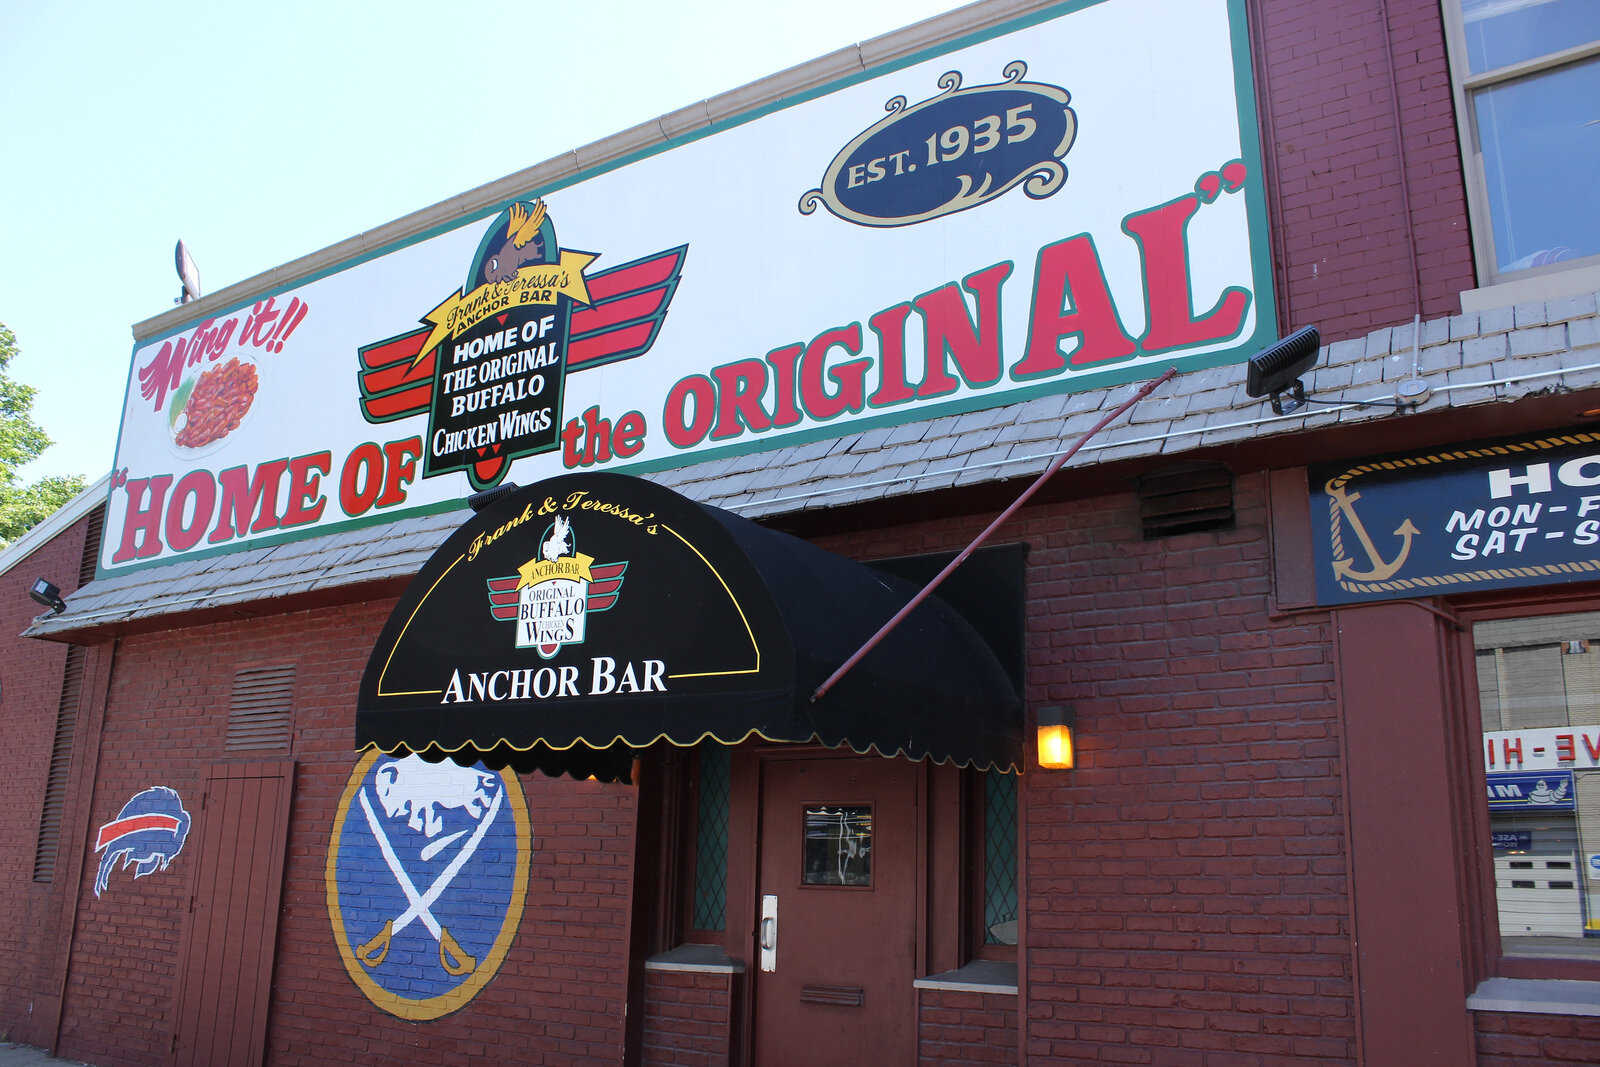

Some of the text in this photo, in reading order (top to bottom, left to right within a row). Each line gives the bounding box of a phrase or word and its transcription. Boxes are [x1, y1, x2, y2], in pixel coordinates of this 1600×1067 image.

[847, 103, 1037, 189] EST. 1935
[446, 287, 491, 330] Frank
[503, 270, 571, 295] Teressa's
[457, 290, 552, 335] ANCHOR BAR
[138, 296, 308, 412] Wing it!!
[453, 314, 555, 365] HOME OF
[442, 342, 559, 394] THE ORIGINAL
[451, 374, 545, 417] BUFFALO
[432, 407, 551, 457] CHICKEN WINGS
[339, 434, 424, 517] OF
[561, 405, 647, 469] the
[1488, 454, 1600, 499] HO
[467, 491, 658, 562] Frank & Teressa's
[528, 586, 576, 602] ORIGINAL
[531, 562, 580, 579] ANCHOR BAR
[520, 598, 585, 620] BUFFALO
[525, 618, 575, 643] WINGS
[541, 620, 566, 629] CHICKEN
[441, 656, 668, 704] ANCHOR BAR
